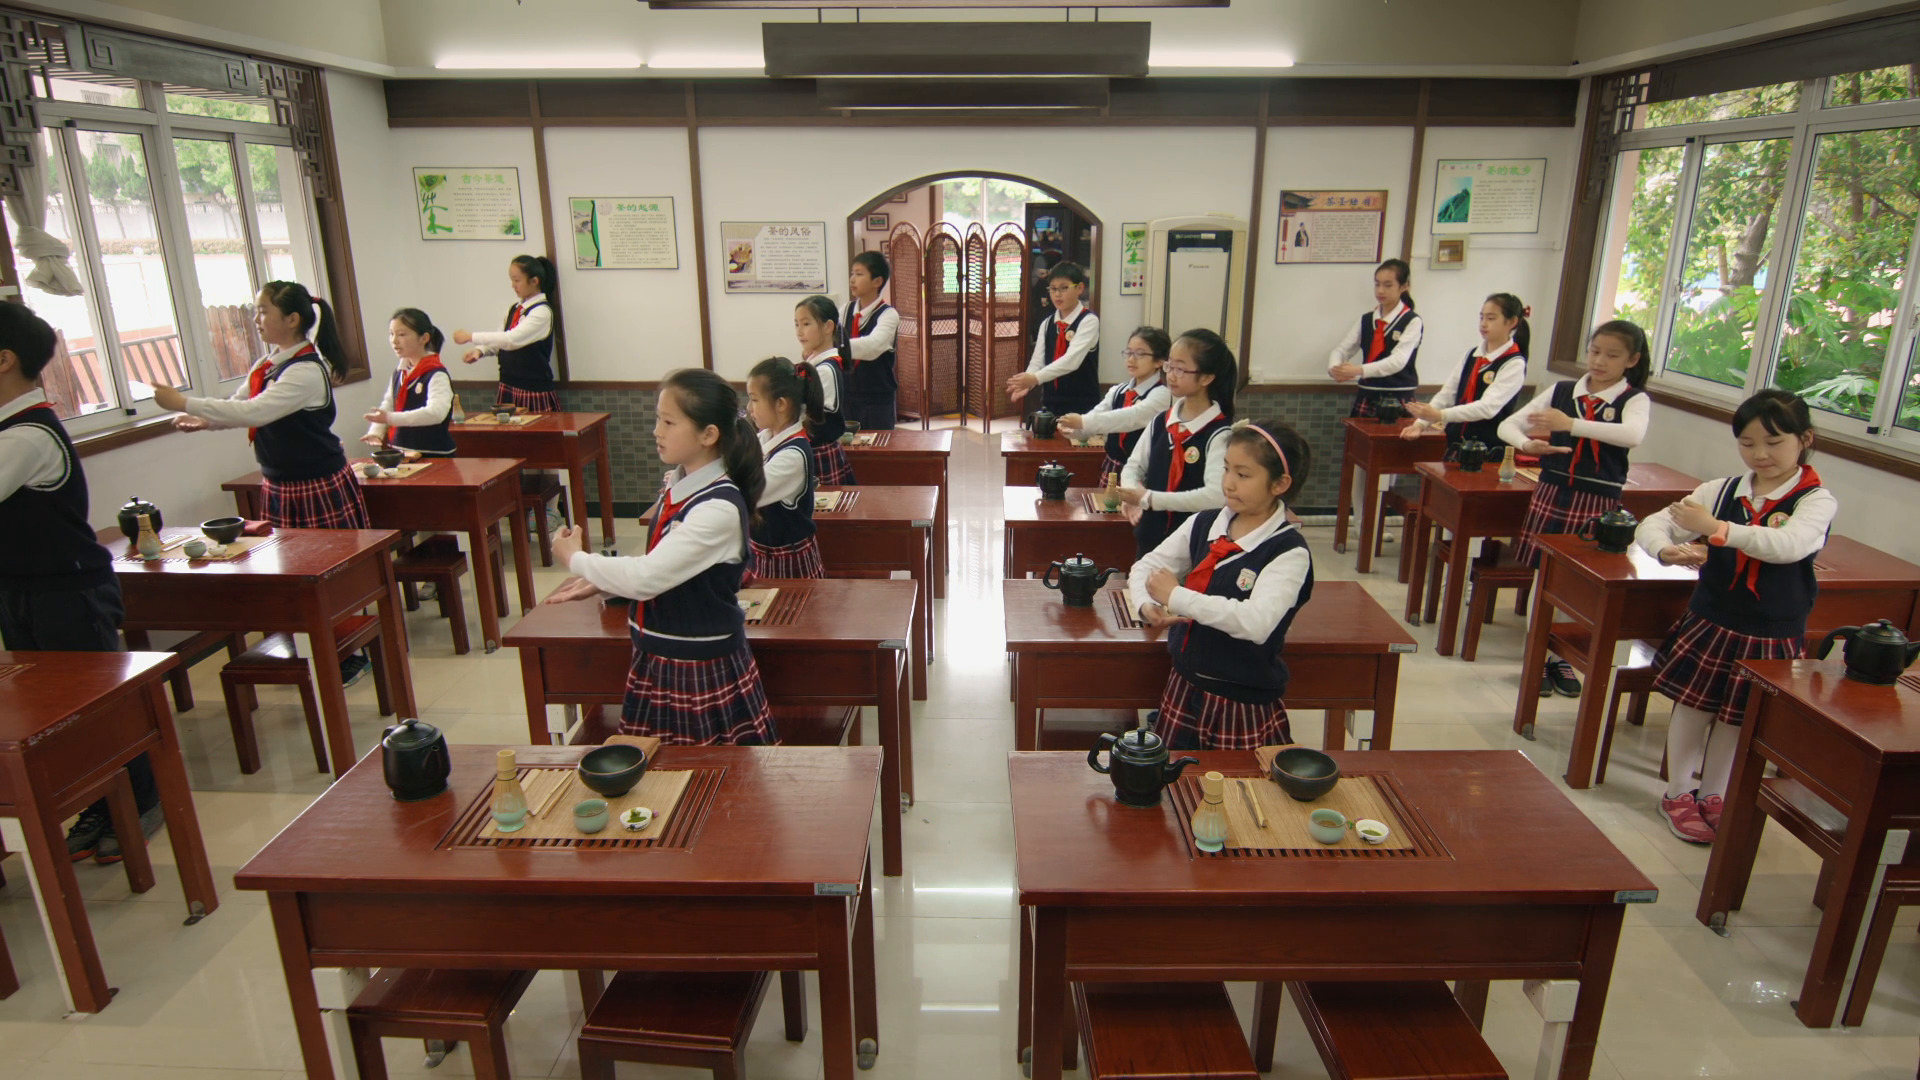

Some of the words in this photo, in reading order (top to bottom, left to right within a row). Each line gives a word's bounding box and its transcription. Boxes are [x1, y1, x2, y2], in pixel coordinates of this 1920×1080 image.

[1487, 165, 1532, 176] 茶的故乡
[616, 203, 660, 212] 茶的起源
[768, 226, 812, 237] 茶的风俗
